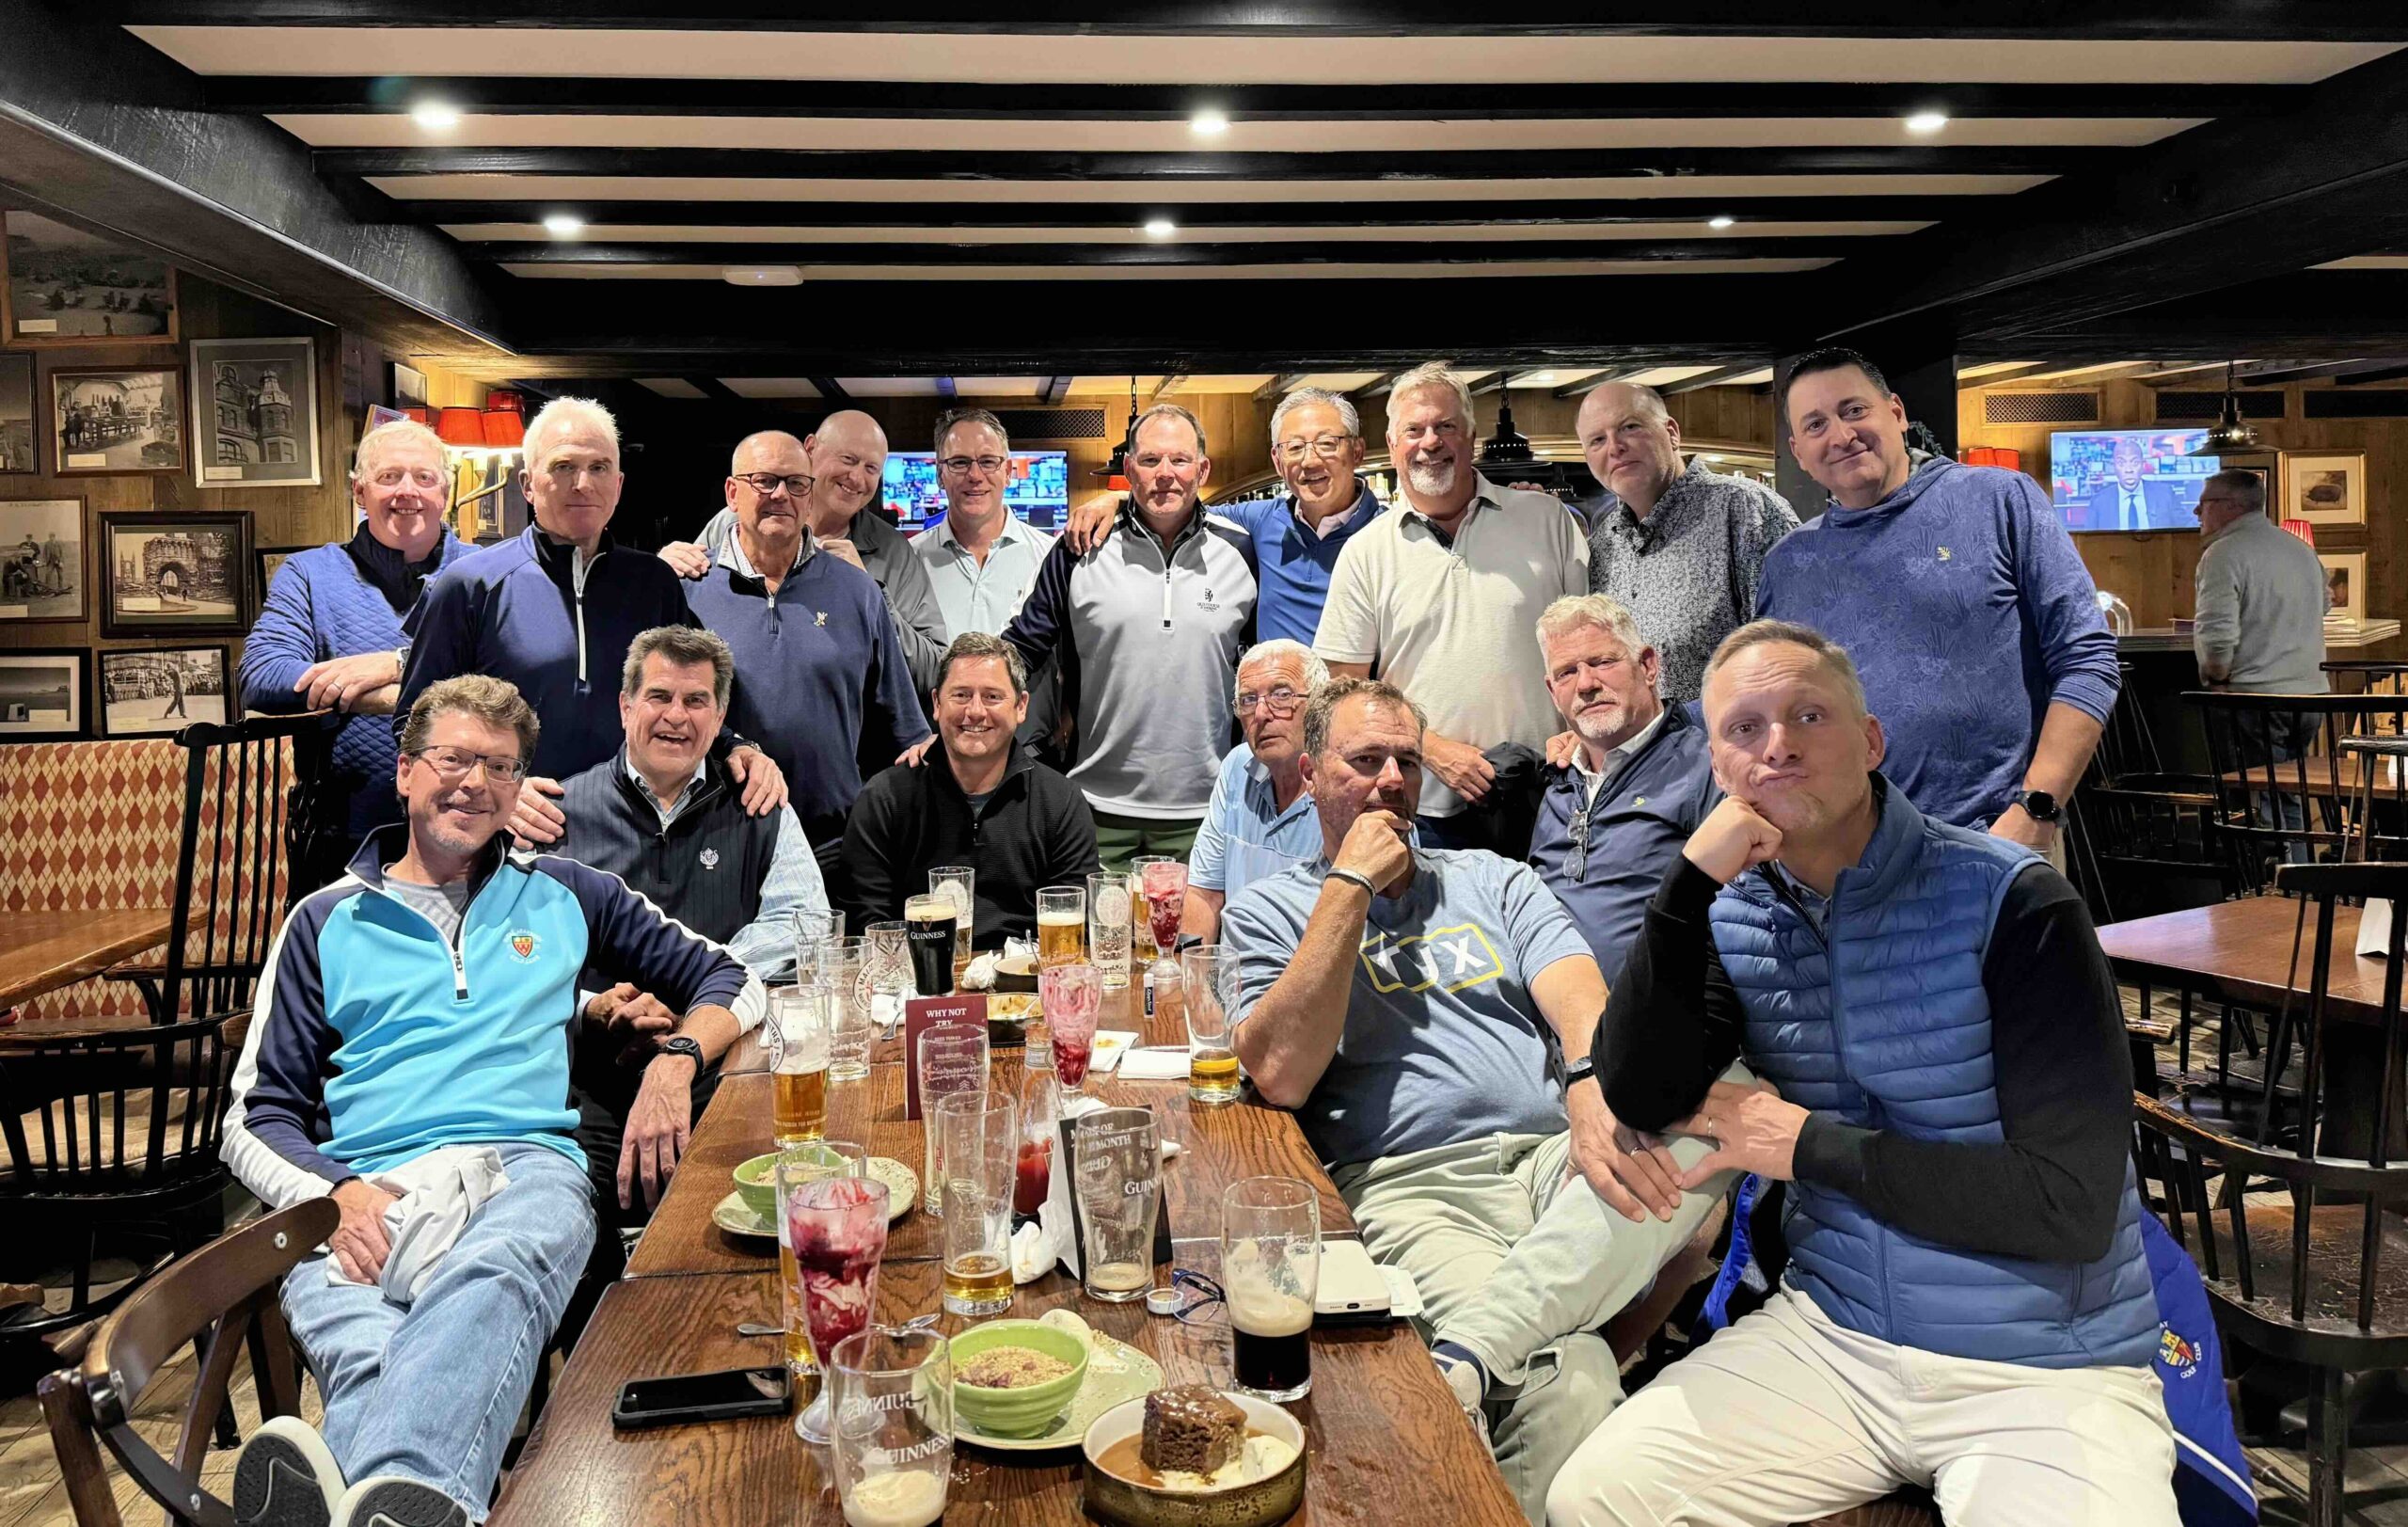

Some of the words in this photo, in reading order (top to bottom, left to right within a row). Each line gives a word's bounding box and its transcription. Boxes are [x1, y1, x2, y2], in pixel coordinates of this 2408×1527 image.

[910, 931, 946, 940] GUINNESS
[926, 1010, 947, 1018] WHY
[948, 1008, 967, 1016] NOT
[935, 1019, 954, 1027] TRY
[1095, 1134, 1133, 1151] MONTH
